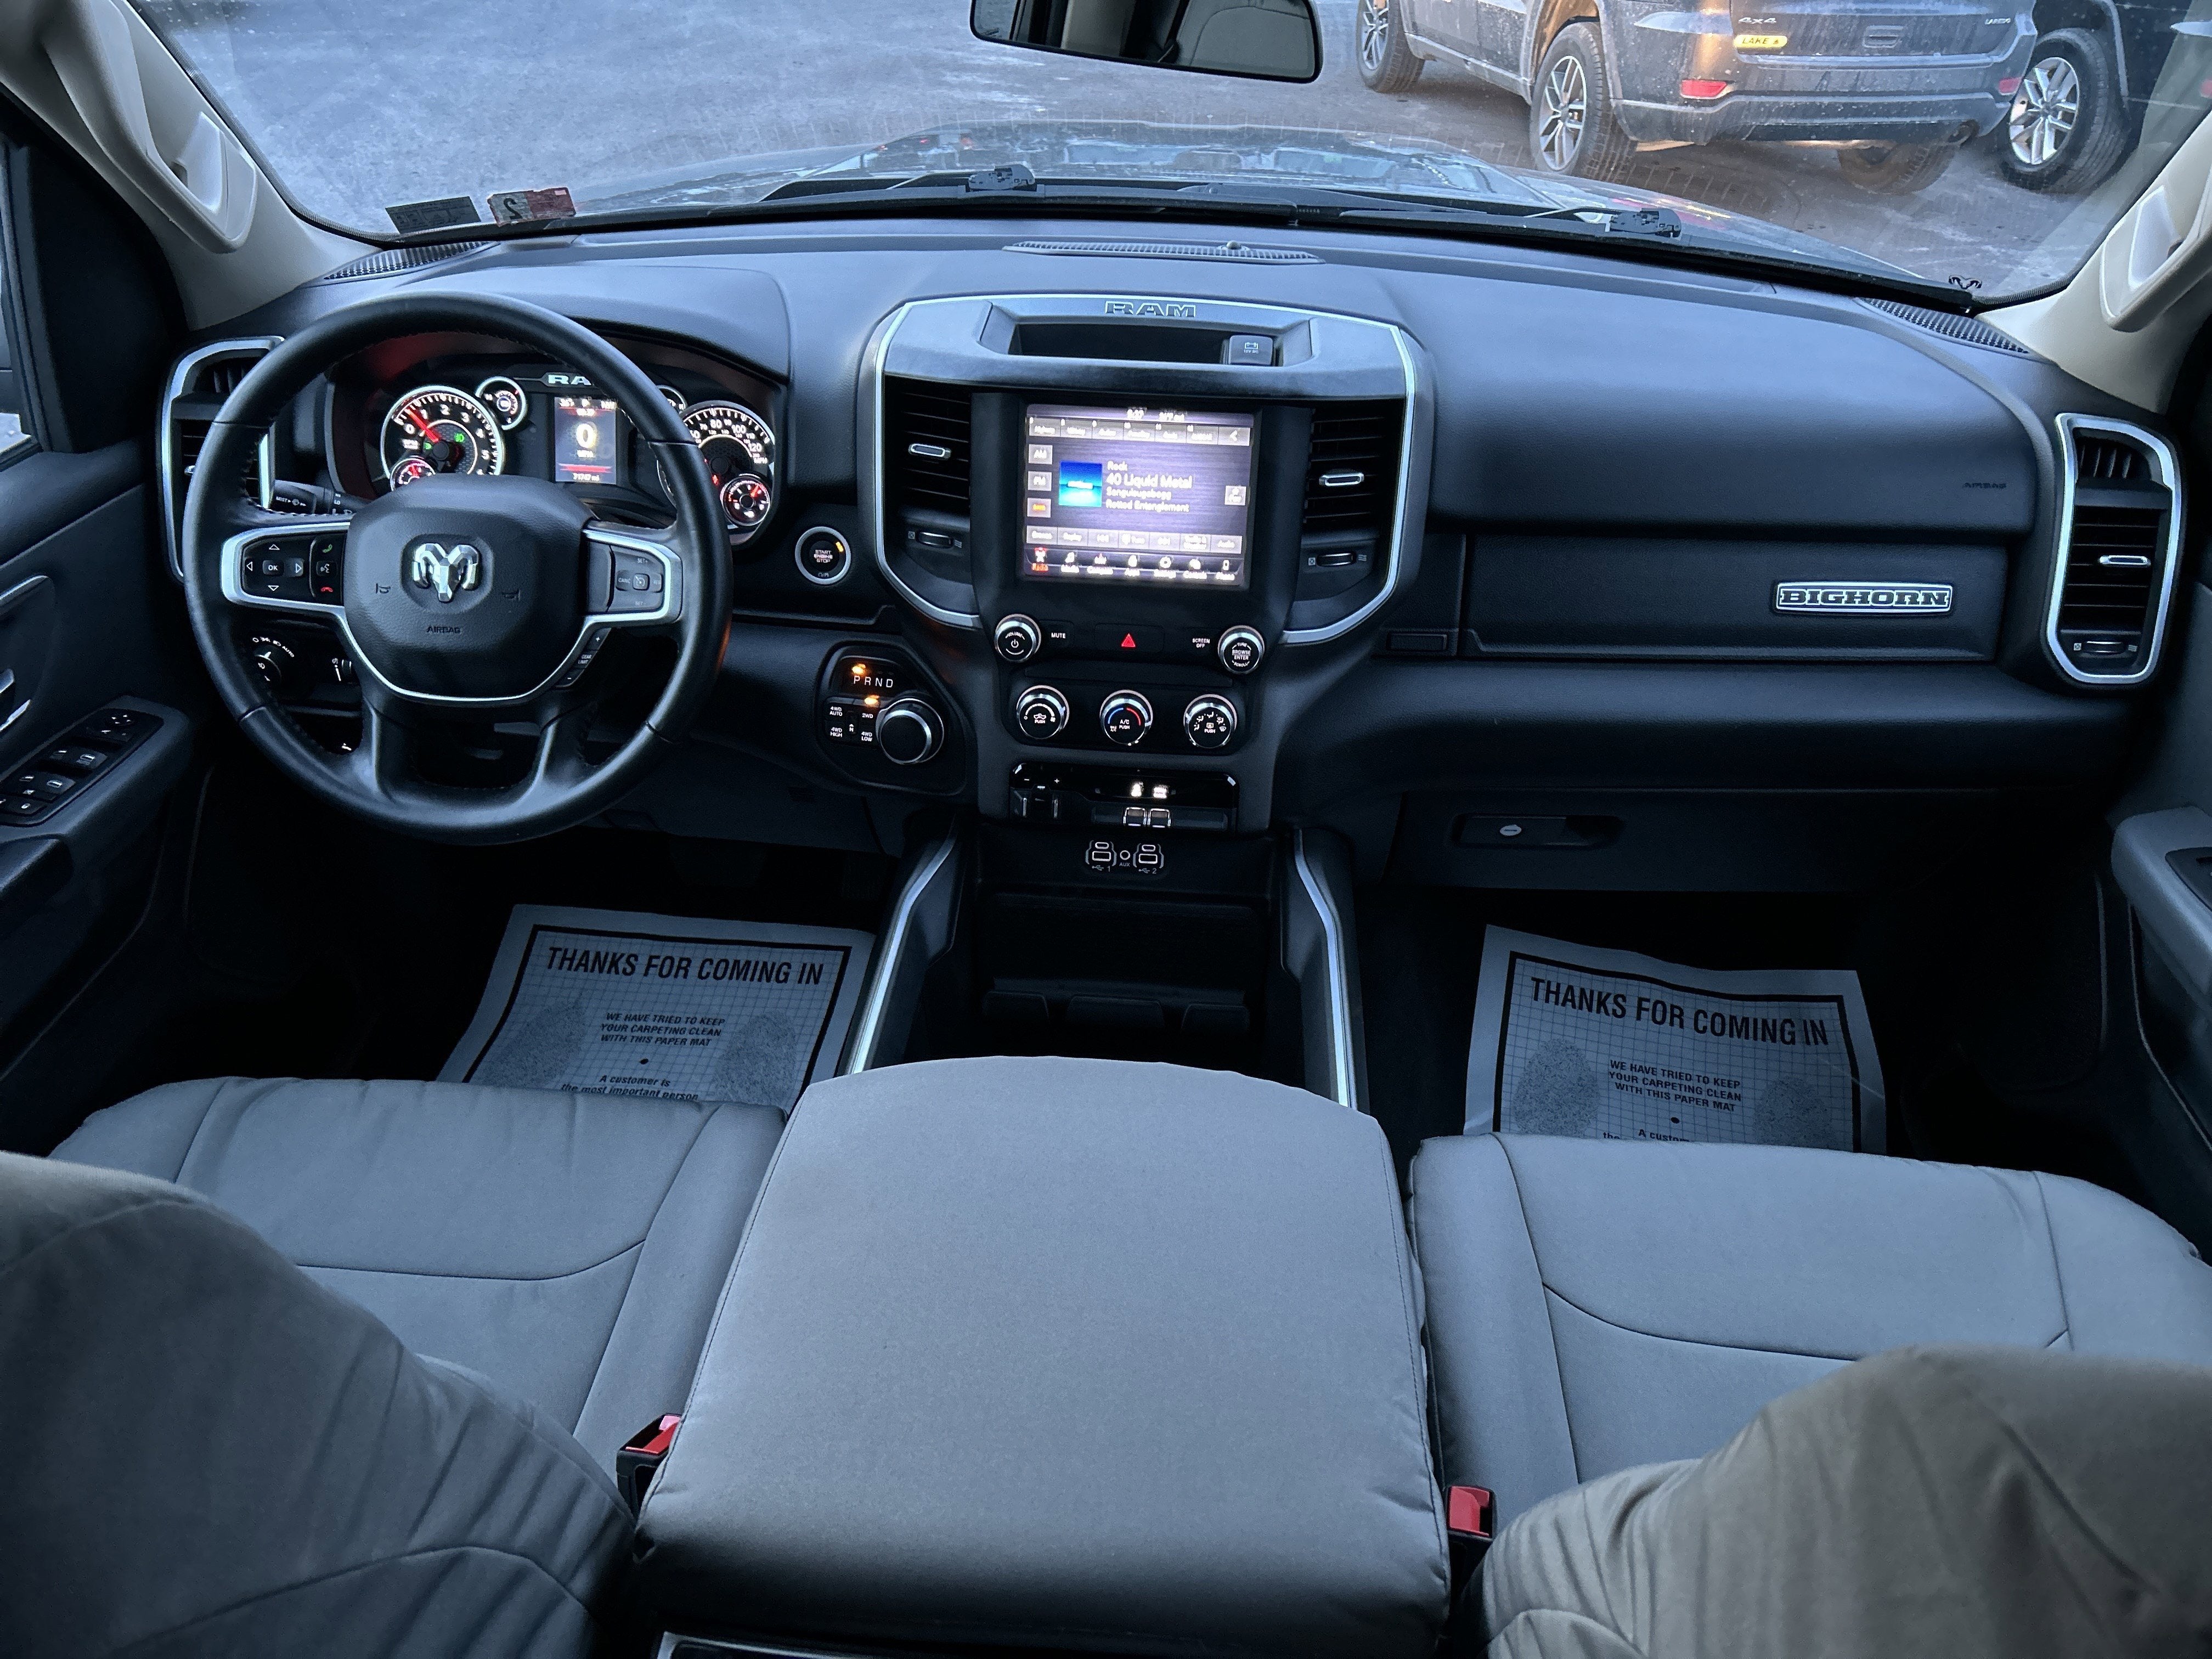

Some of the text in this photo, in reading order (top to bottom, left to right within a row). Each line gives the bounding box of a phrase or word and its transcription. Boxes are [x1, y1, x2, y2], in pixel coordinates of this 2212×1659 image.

[1105, 301, 1196, 318] RAM
[548, 374, 592, 386] RA
[439, 404, 450, 415] 2
[461, 412, 471, 424] 3
[710, 420, 722, 430] 80
[731, 424, 746, 434] 100
[476, 428, 486, 439] 4
[575, 422, 597, 449] 0
[481, 449, 491, 460] 5
[748, 443, 763, 453] 120
[1034, 449, 1047, 459] AM
[1107, 461, 1128, 471] Rock
[1106, 472, 1122, 486] 40
[1124, 473, 1159, 488] Liquid
[1160, 475, 1193, 488] Metal
[1134, 500, 1190, 512] Entanglement
[1780, 587, 1950, 607] BIGHORN
[281, 645, 295, 658] AUTO
[853, 675, 894, 688] P R N D
[548, 947, 823, 985] THANKS FOR COMING IN
[1531, 977, 1829, 1045] THANKS FOR COMING IN
[606, 1013, 726, 1026] WE HAVE TRIED TO KEEP
[601, 1023, 722, 1036] YOUR CARPETING CLEAN
[601, 1034, 712, 1047] WITH THIS PAPER MAT
[599, 1074, 671, 1087] A customer is
[1610, 1059, 1740, 1089] WE HAVE TRIED TO KEEP
[561, 1083, 578, 1092] the
[580, 1086, 607, 1094] most
[609, 1086, 661, 1098] important
[1609, 1071, 1742, 1102] YOUR CARPETING CLEAN
[1615, 1082, 1736, 1112] WITH THIS PAPER MAT
[1638, 1128, 1646, 1137] A
